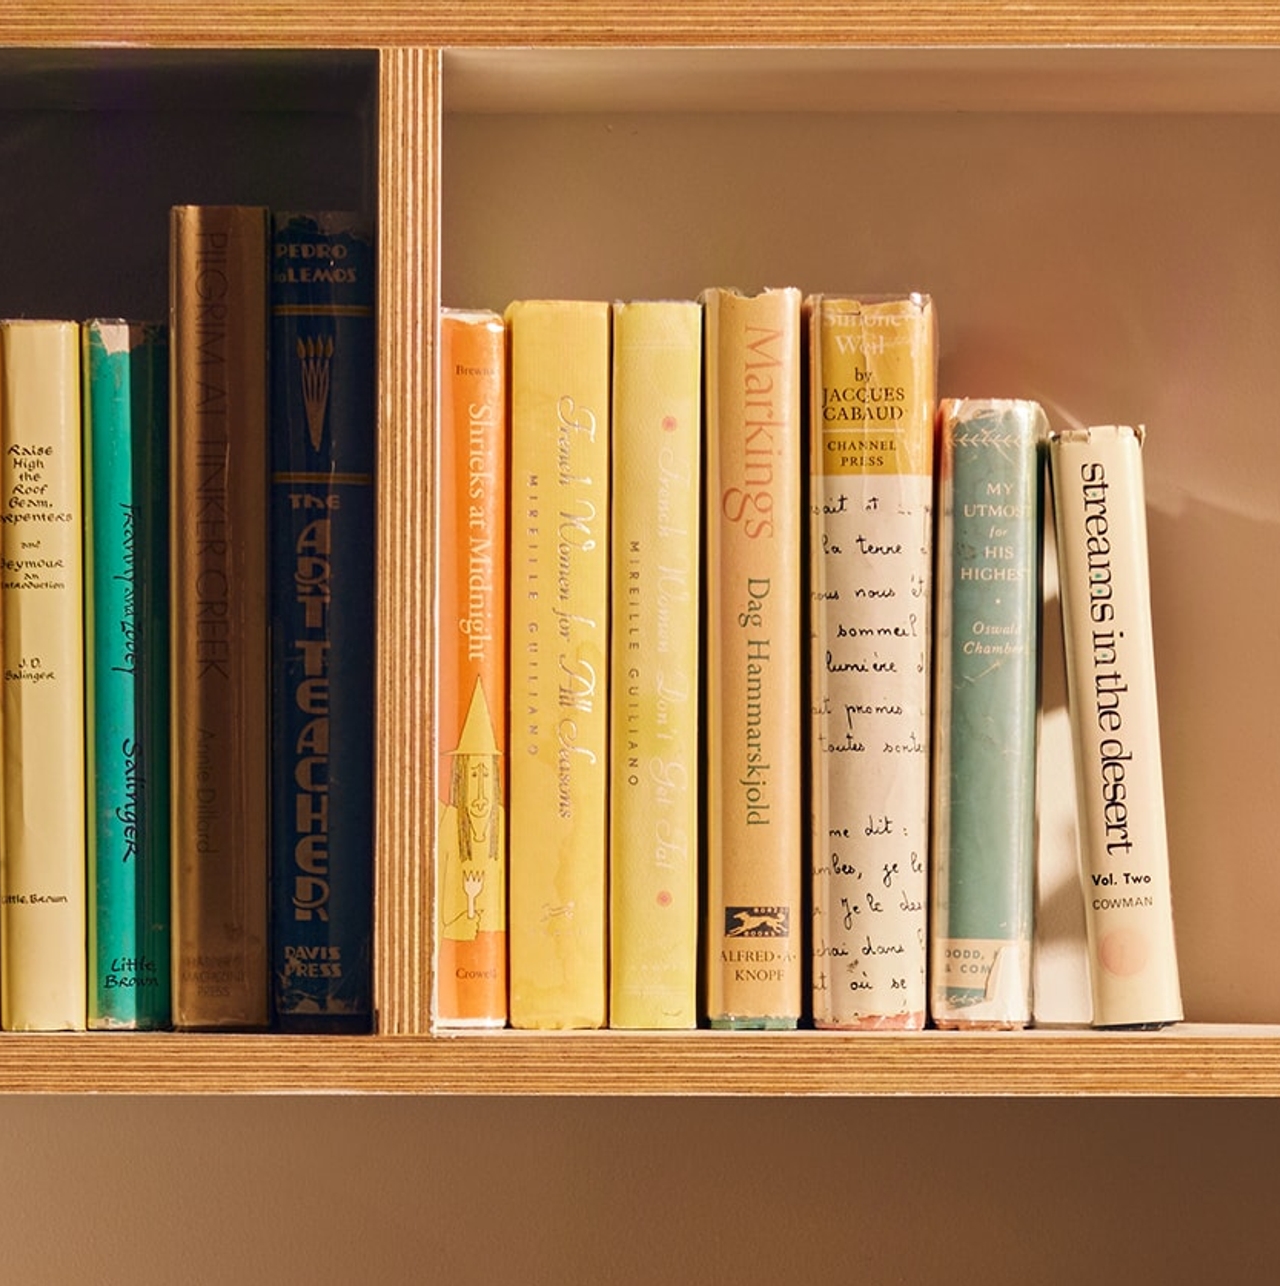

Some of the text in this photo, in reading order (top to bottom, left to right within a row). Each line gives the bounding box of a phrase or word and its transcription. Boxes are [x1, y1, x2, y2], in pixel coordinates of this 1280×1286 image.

[275, 243, 348, 259] PEDRO
[835, 336, 885, 355] Weil
[854, 367, 872, 383] by
[822, 387, 905, 408] JACQUES
[823, 407, 904, 421] CABAUD
[723, 326, 785, 540] Markings
[7, 444, 53, 456] Raise
[827, 440, 896, 451] CHANNEL
[196, 232, 229, 678] PILGRIM TINKER CREEK
[841, 456, 884, 467] PRESS
[13, 458, 45, 472] High
[19, 472, 42, 482] the
[12, 484, 49, 495] Roof
[986, 483, 1014, 496] MY
[459, 403, 494, 661] Shrieks at Midnight
[989, 525, 1008, 539] for
[856, 534, 902, 554] terre
[984, 546, 1015, 559] HIS
[288, 494, 341, 628] THE ART
[855, 587, 896, 598] nous
[556, 396, 597, 819] French Women Seasons
[738, 578, 770, 627] Dag
[526, 474, 539, 756] MIREILLE GUILIANO
[837, 613, 918, 637] sommeil
[628, 541, 641, 786] MIREILLE GUILIANO
[1080, 463, 1133, 856] streams in the desert
[4, 669, 56, 682] Salinger
[846, 702, 903, 729] promis
[292, 640, 331, 921] TEACHER
[115, 738, 145, 863] Salinger
[829, 828, 850, 838] me
[1092, 872, 1151, 886] Vol. Two
[30, 894, 68, 904] Brown
[1092, 897, 1153, 910] COWMAN
[283, 946, 342, 978] DAVIS PRESS
[456, 968, 496, 979] Crowell
[735, 969, 785, 981] KNOPF
[104, 974, 158, 990] Brown
